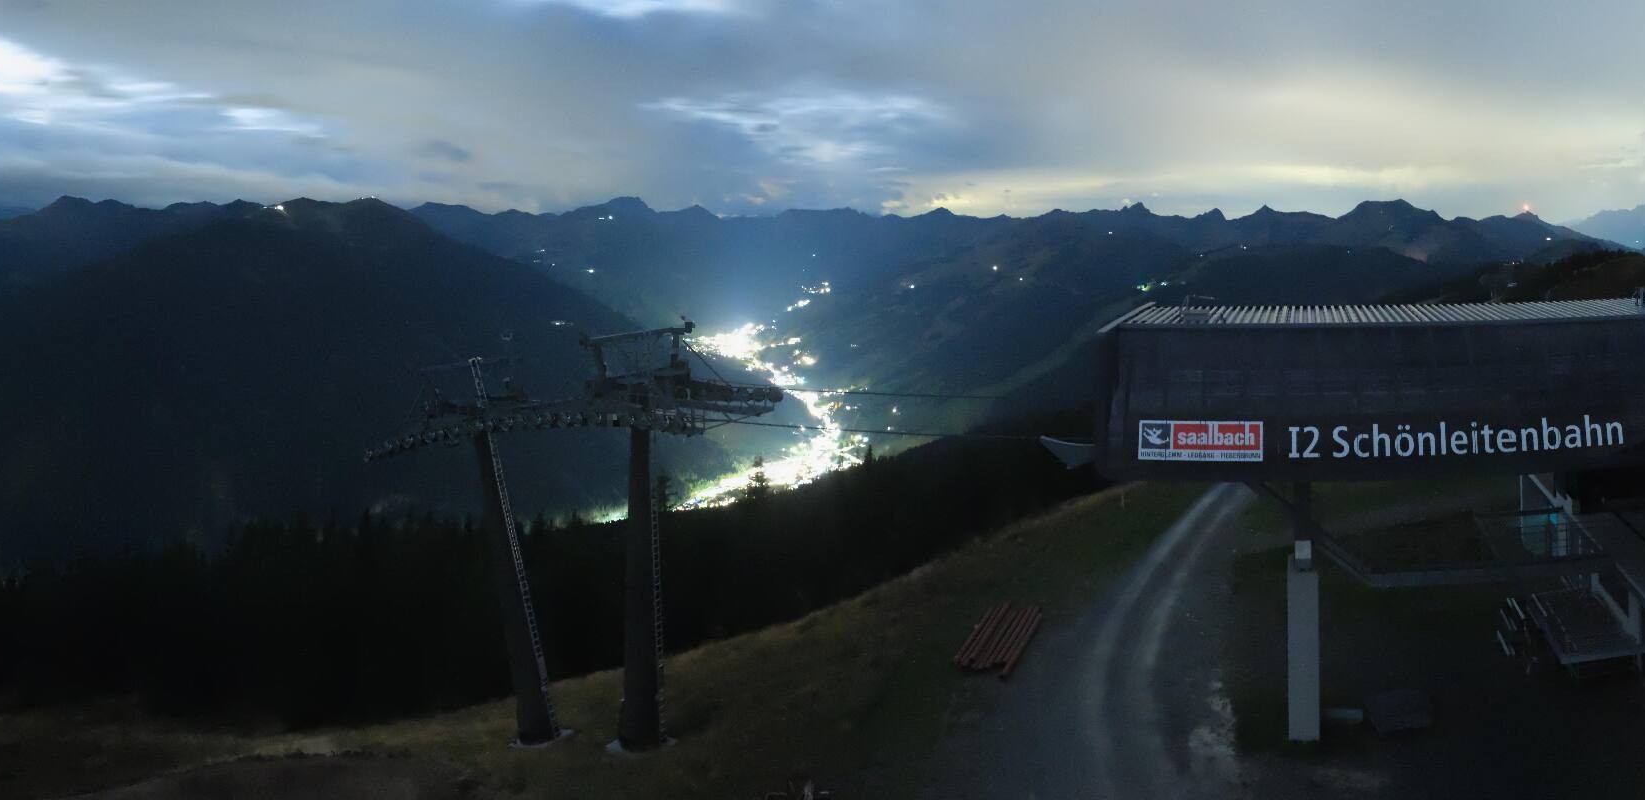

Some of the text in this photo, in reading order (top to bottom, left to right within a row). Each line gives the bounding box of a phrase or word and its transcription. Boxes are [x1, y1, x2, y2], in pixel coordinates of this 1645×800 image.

[1177, 421, 1255, 446] saalbach
[1288, 414, 1625, 458] I2 Schönleitenbahn
